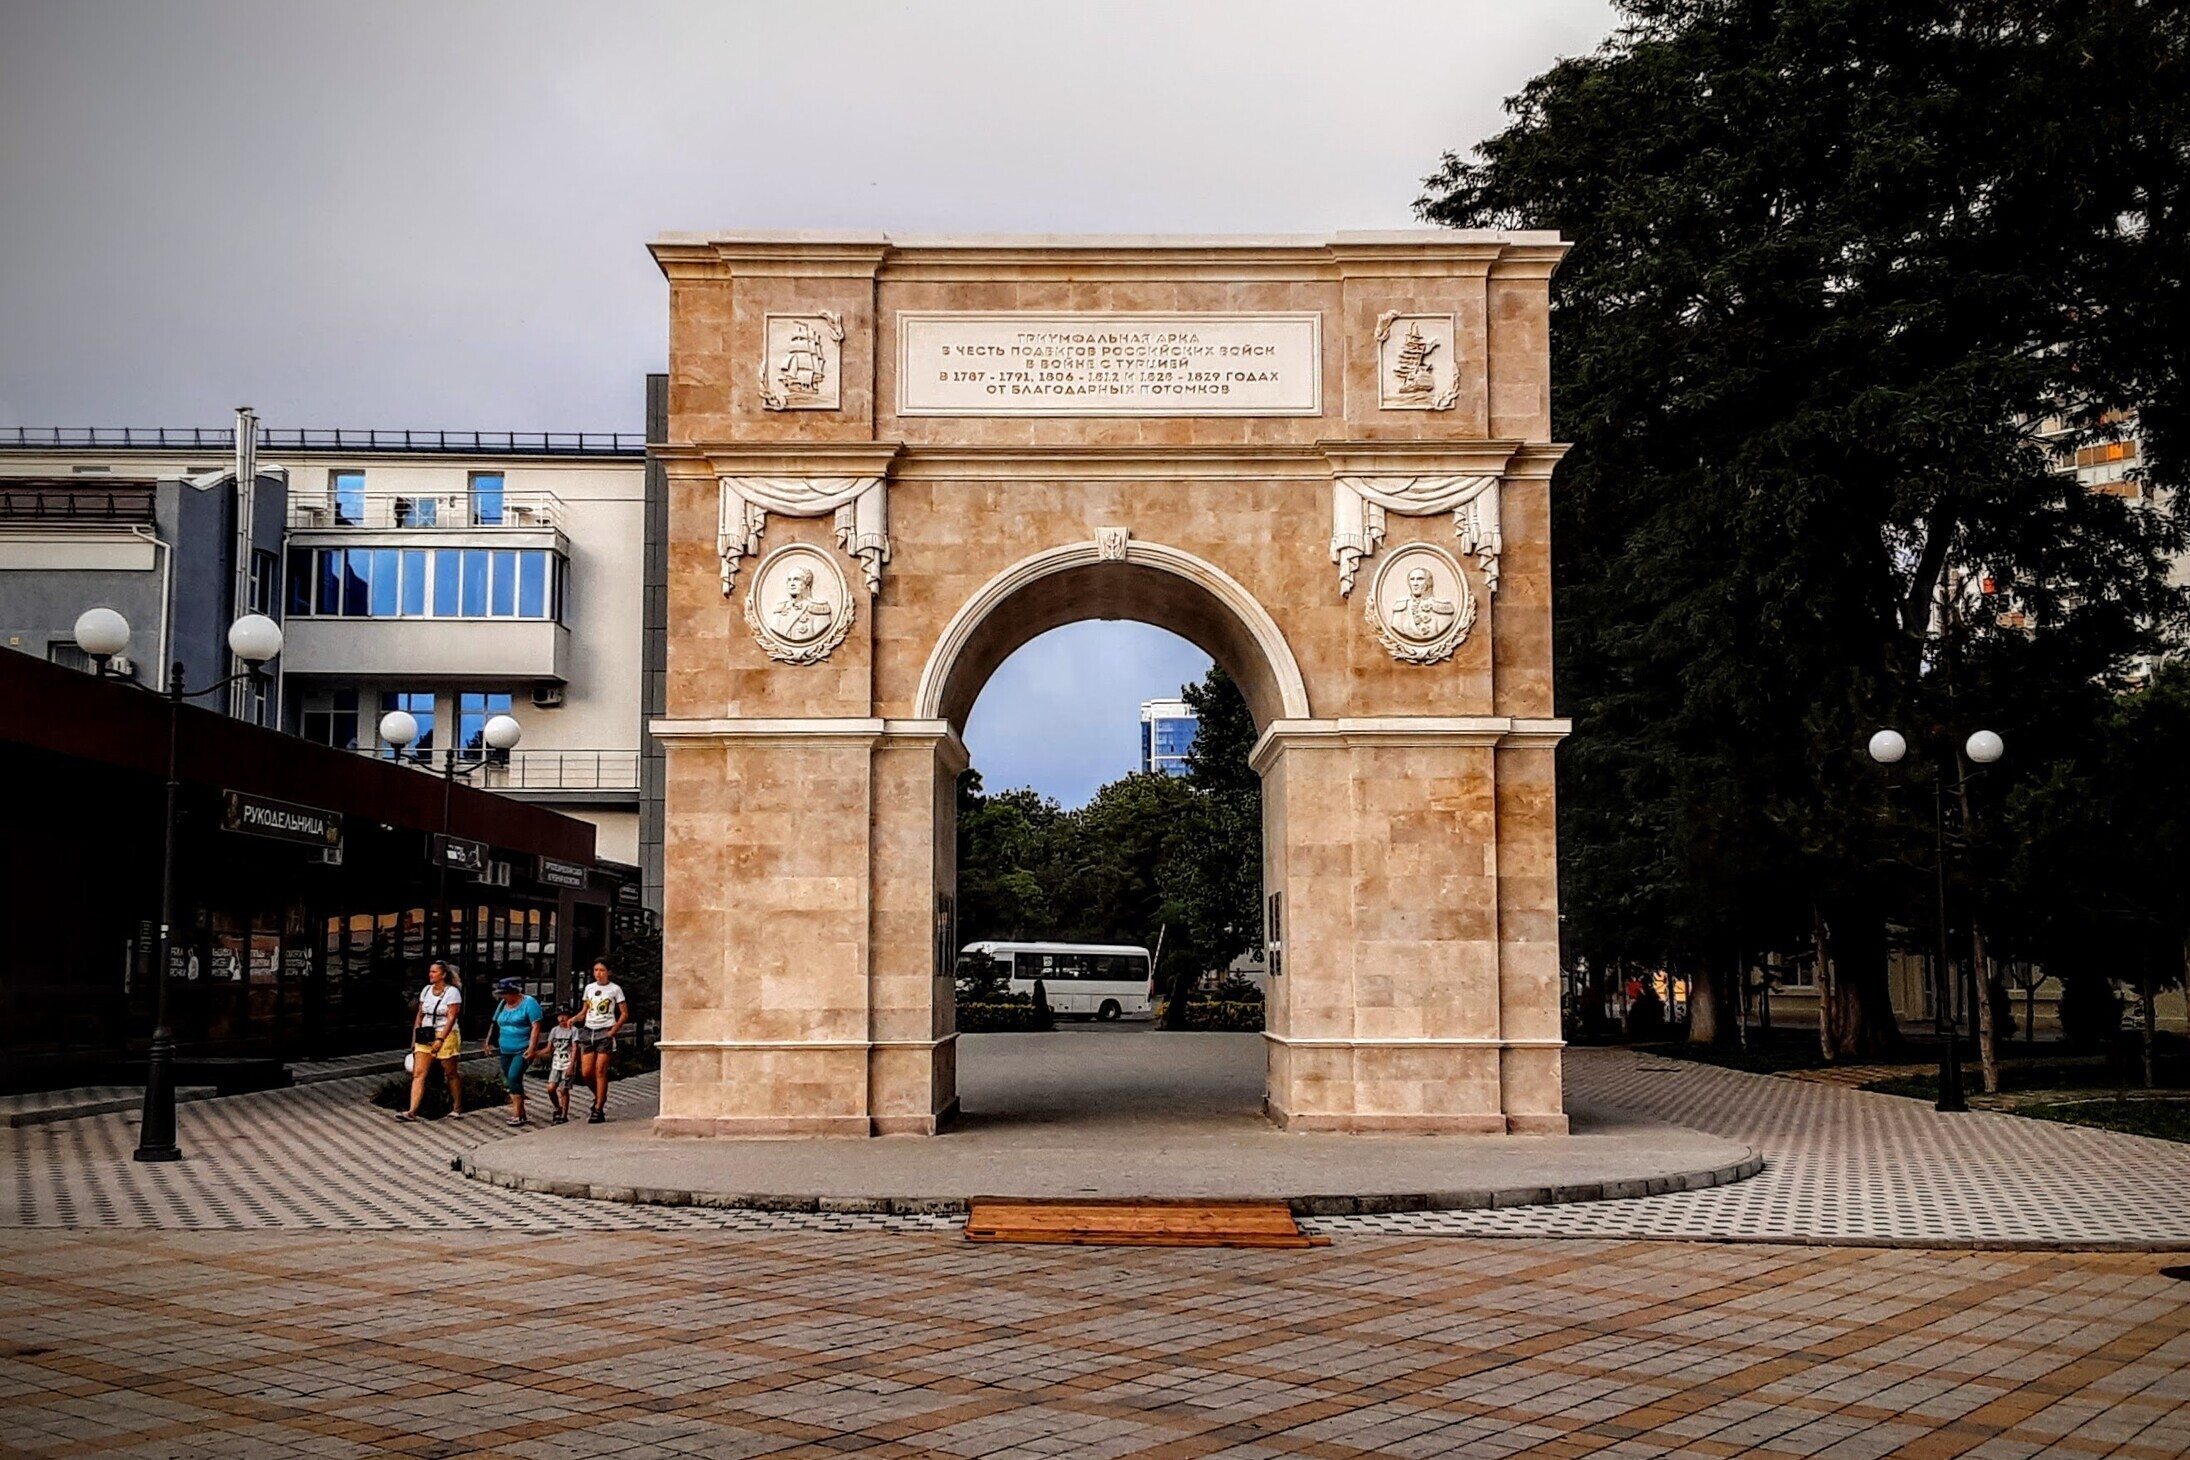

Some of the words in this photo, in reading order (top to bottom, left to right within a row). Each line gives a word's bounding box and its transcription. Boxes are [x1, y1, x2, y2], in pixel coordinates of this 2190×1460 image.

[1016, 333, 1150, 344] ТРИУМФАЛЬНАЯ
[1156, 333, 1200, 344] АРКА
[956, 345, 1005, 356] ЧЕСТЬ
[1010, 346, 1097, 356] ПОДВИГОВ
[1101, 344, 1214, 356] РОССИЙСКИХ
[1219, 344, 1276, 356] ВОЙСК
[1026, 359, 1034, 369] В
[1040, 357, 1095, 369] ВОЙНЕ
[1100, 359, 1111, 369] С
[1115, 357, 1190, 369] ТУРЦИЕЙ
[939, 372, 948, 382] В
[953, 372, 986, 382] 1787
[999, 372, 1034, 383] 1791,
[1039, 372, 1074, 382] 1806
[1088, 372, 1119, 382] 1812
[1140, 372, 1173, 382] 1828
[1187, 372, 1221, 382] 1829
[1226, 372, 1279, 382] ГОДАХ
[986, 385, 1007, 395] ОТ
[1011, 385, 1135, 395] БЛАГОДАРНЫХ
[1140, 385, 1231, 395] ПОТОМКОВ
[243, 805, 324, 835] РУКОДЕЛЬНИЦА
